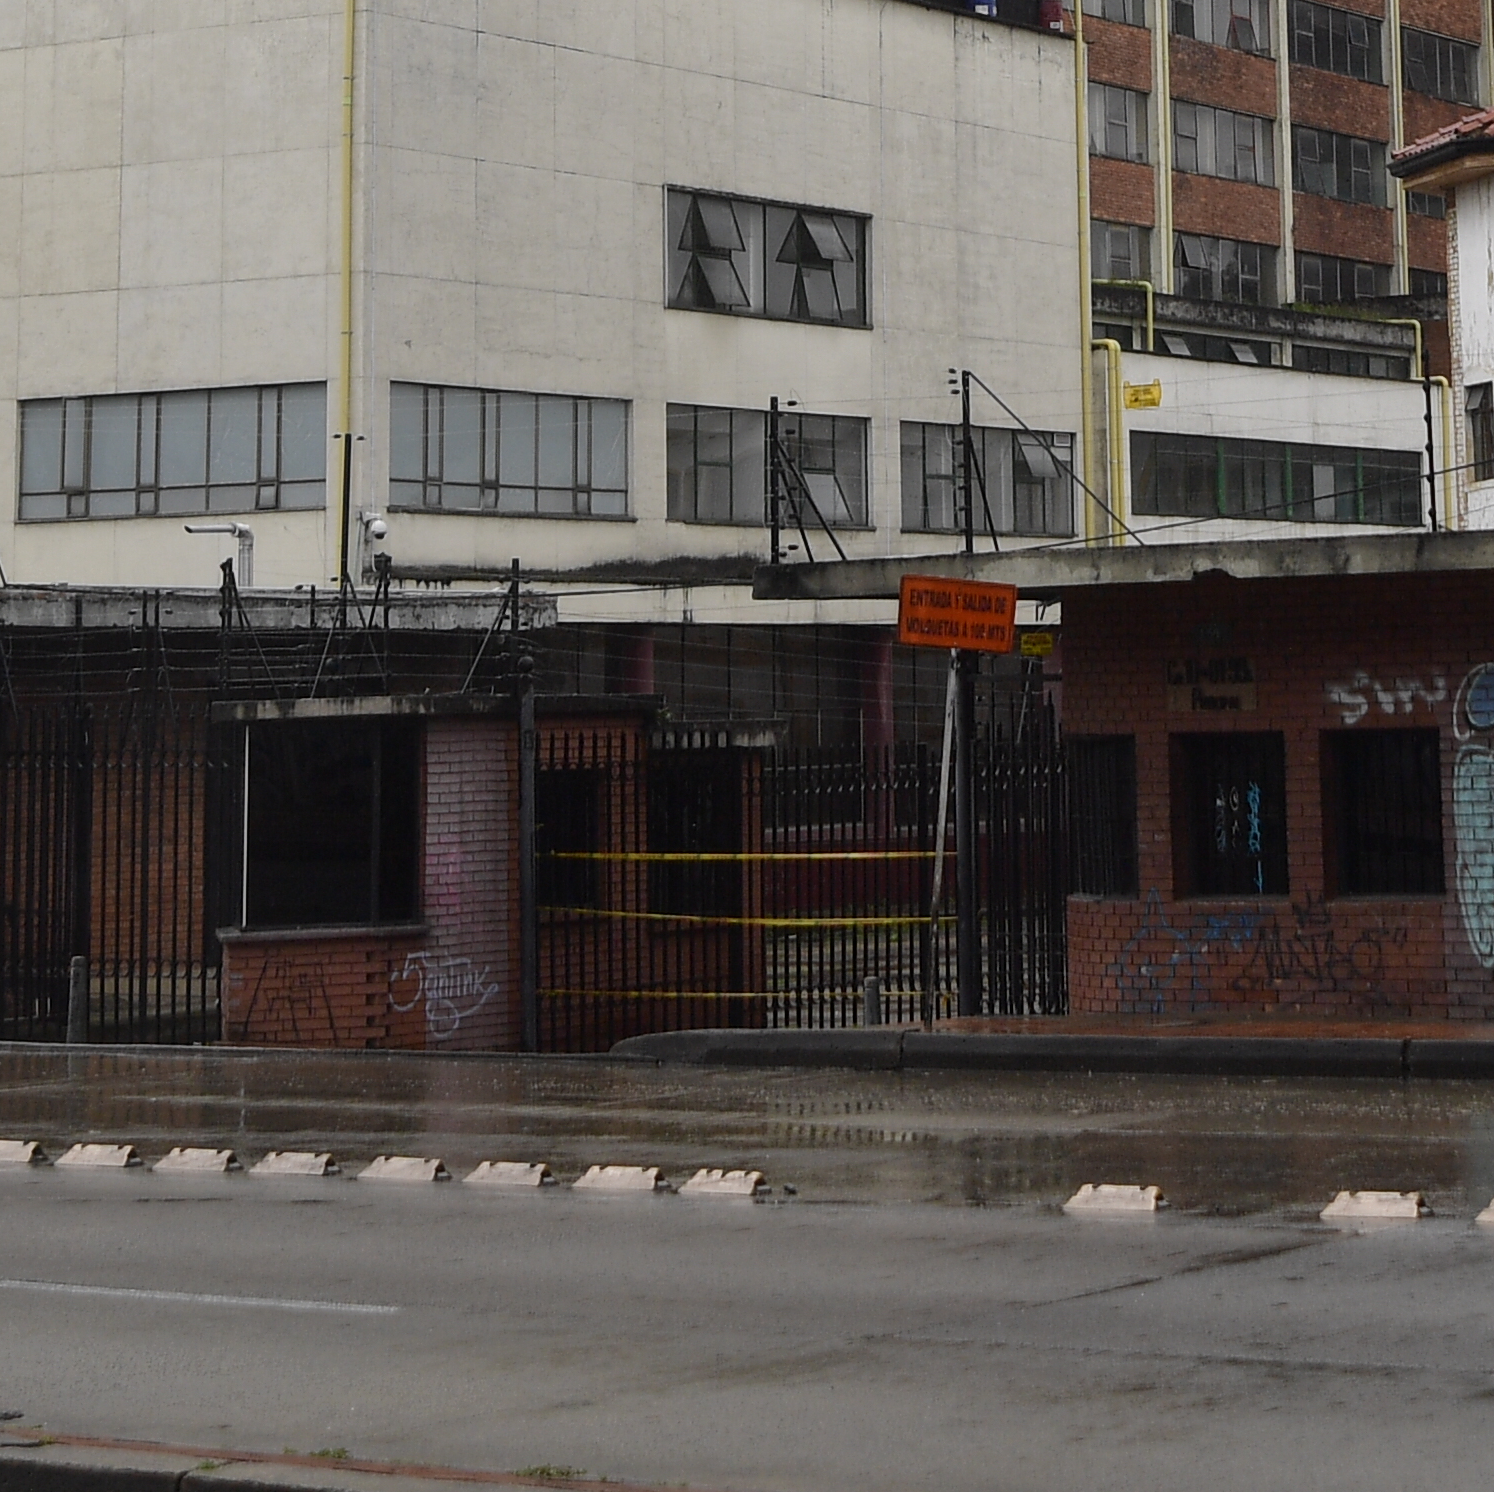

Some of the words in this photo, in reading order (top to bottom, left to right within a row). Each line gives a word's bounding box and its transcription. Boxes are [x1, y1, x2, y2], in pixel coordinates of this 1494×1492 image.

[910, 588, 951, 608] ENTRADA
[963, 593, 992, 611] SALIDA
[994, 596, 1007, 614] DE
[906, 616, 959, 637] VOLQUETAS
[988, 624, 1006, 641] MTS
